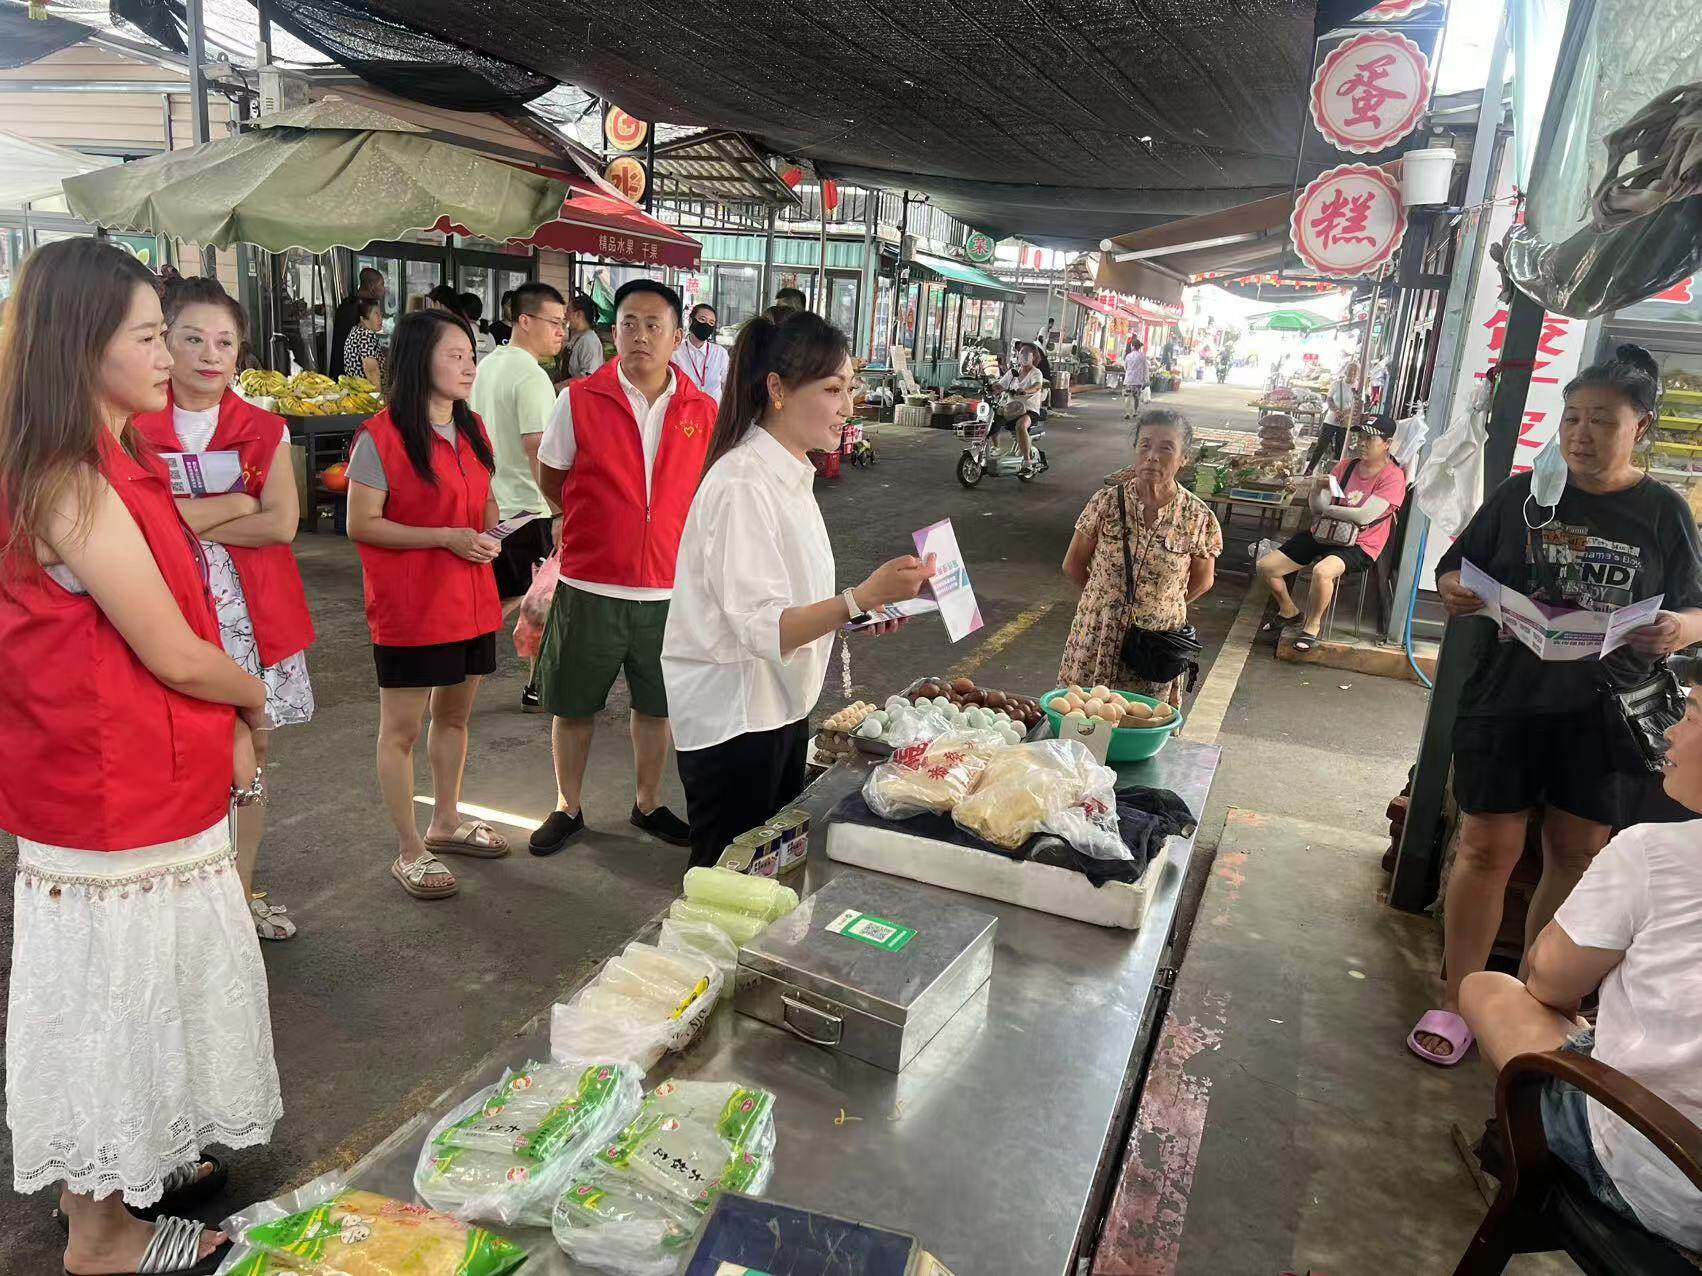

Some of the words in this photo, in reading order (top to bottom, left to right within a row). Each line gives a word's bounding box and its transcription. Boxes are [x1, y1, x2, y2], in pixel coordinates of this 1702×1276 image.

[1336, 54, 1407, 129] 蛋
[611, 166, 639, 197] 水
[1311, 188, 1376, 250] 糕
[598, 234, 634, 255] 精品水果
[641, 242, 658, 260] 干果
[970, 236, 989, 255] 菜
